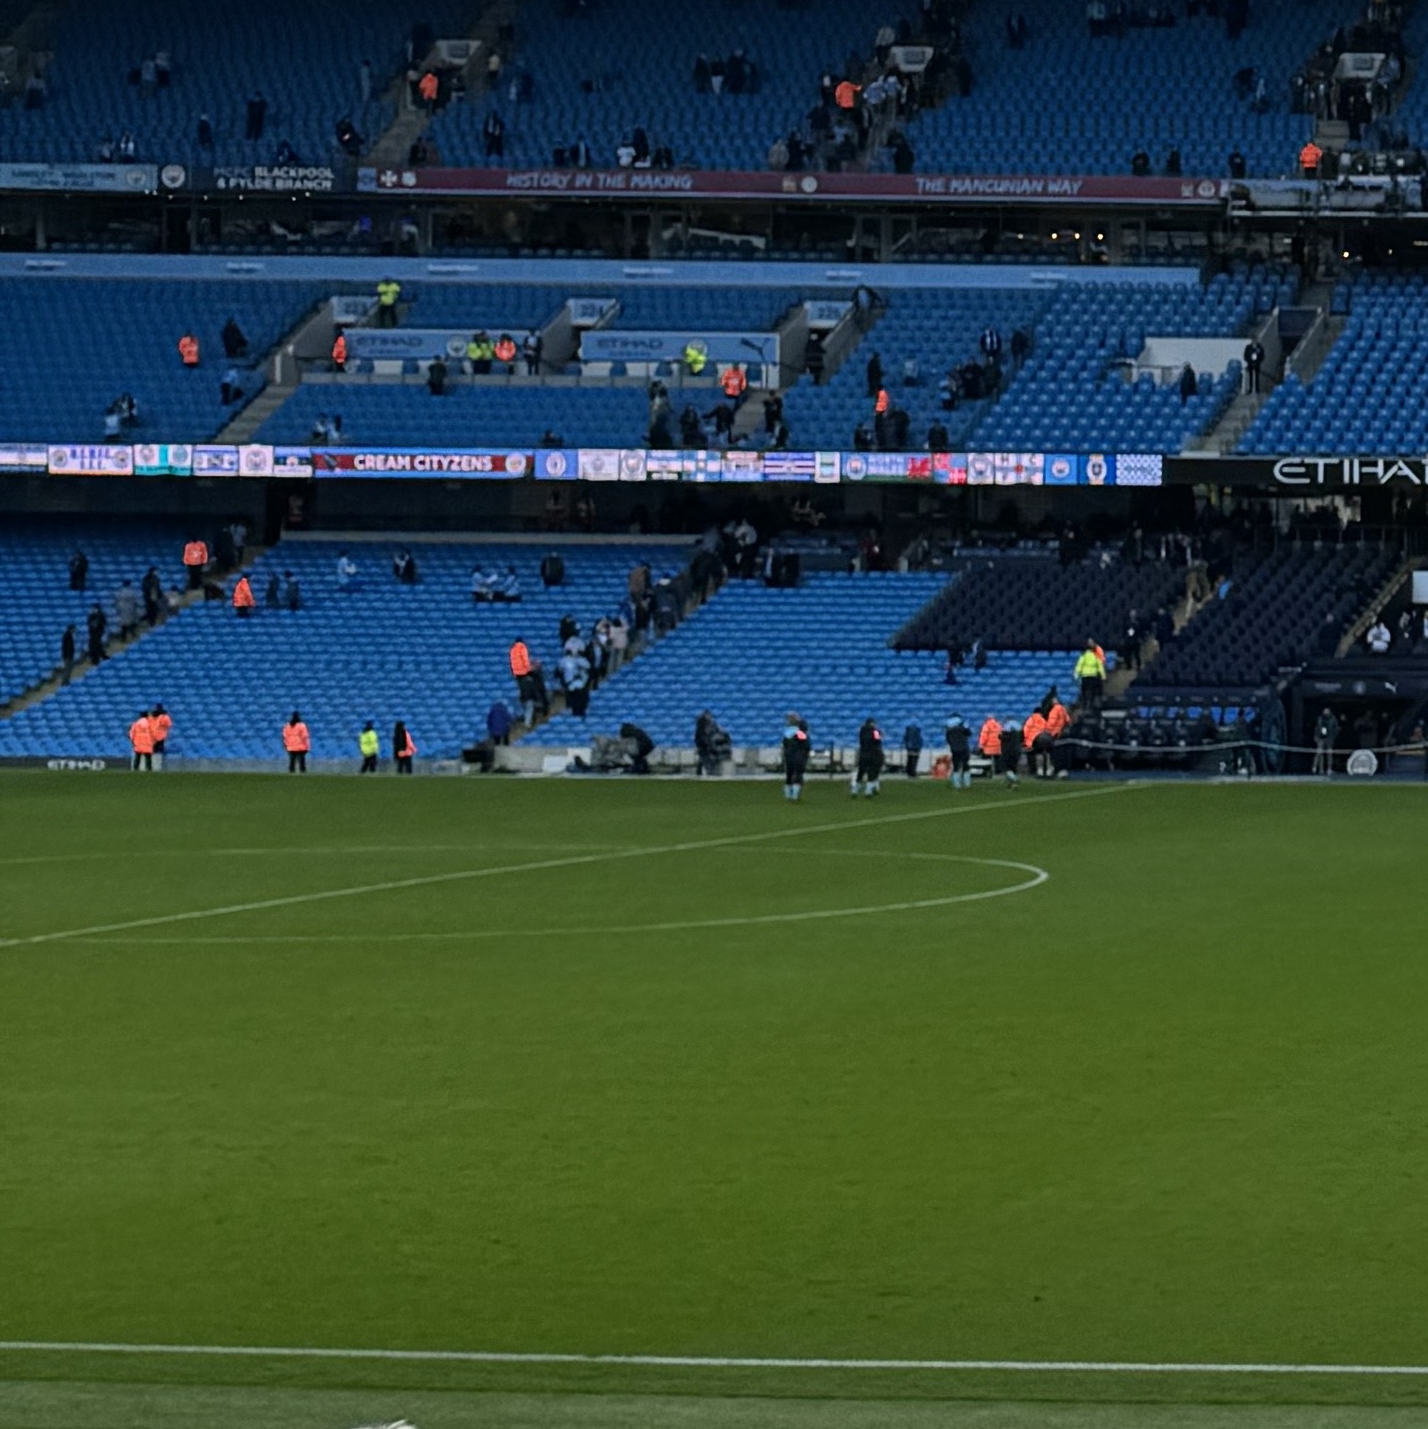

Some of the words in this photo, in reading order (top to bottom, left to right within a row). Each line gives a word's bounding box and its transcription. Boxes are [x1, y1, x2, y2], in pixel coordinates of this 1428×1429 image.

[254, 166, 335, 179] BLACKPOOL
[275, 179, 333, 191] BRANCH
[507, 173, 570, 189] HISTORY
[575, 174, 592, 189] IN
[598, 175, 627, 189] THE
[630, 175, 693, 190] MAKING
[916, 177, 947, 193] THE
[949, 179, 1043, 194] MANCUNIAN
[1046, 179, 1082, 195] WAY
[356, 336, 423, 347] ETIHAD
[597, 338, 664, 349] ETIHAD
[353, 455, 411, 471] CREAM
[413, 455, 493, 472] CITYZENS
[47, 759, 106, 771] ETIHAD
